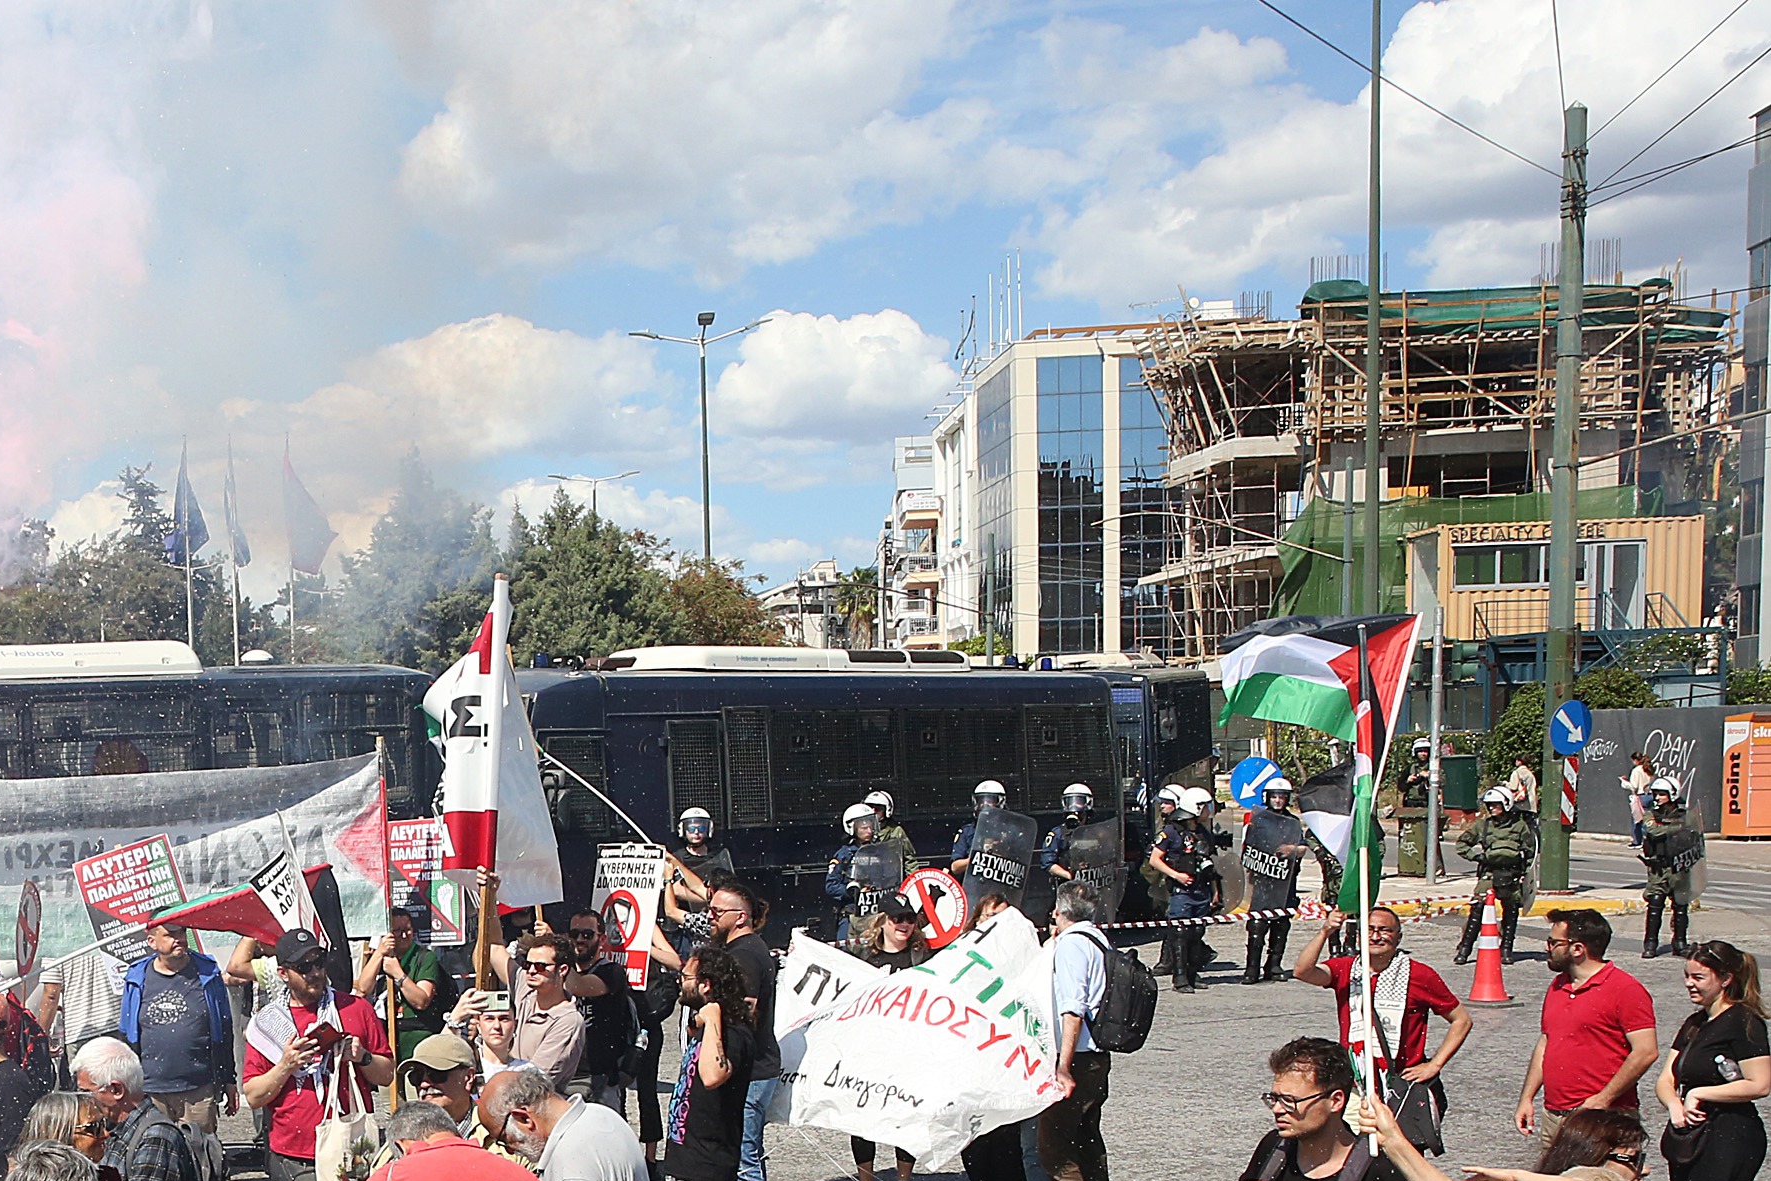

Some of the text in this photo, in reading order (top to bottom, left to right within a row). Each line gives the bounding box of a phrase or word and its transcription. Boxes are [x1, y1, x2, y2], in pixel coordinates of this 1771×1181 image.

[1450, 526, 1533, 541] SPECIALTY
[1726, 752, 1741, 814] point
[82, 842, 166, 882] ΛΕΥΤΕΡΙΑ
[971, 852, 1025, 878] ΑΣΤΥΝΟΜΙΑ
[1246, 845, 1288, 868] POLICE
[601, 862, 655, 875] ΚΥΒΕΡΝΗΣΗ
[972, 865, 1022, 888] POLICE
[87, 865, 172, 904] ΠΑΛΑΙΣΤΙΝΗ
[133, 880, 176, 902] ΙΟΡΔΑΝΗ
[597, 876, 655, 889] ΔΟΛΟΦΟΝΩΝ
